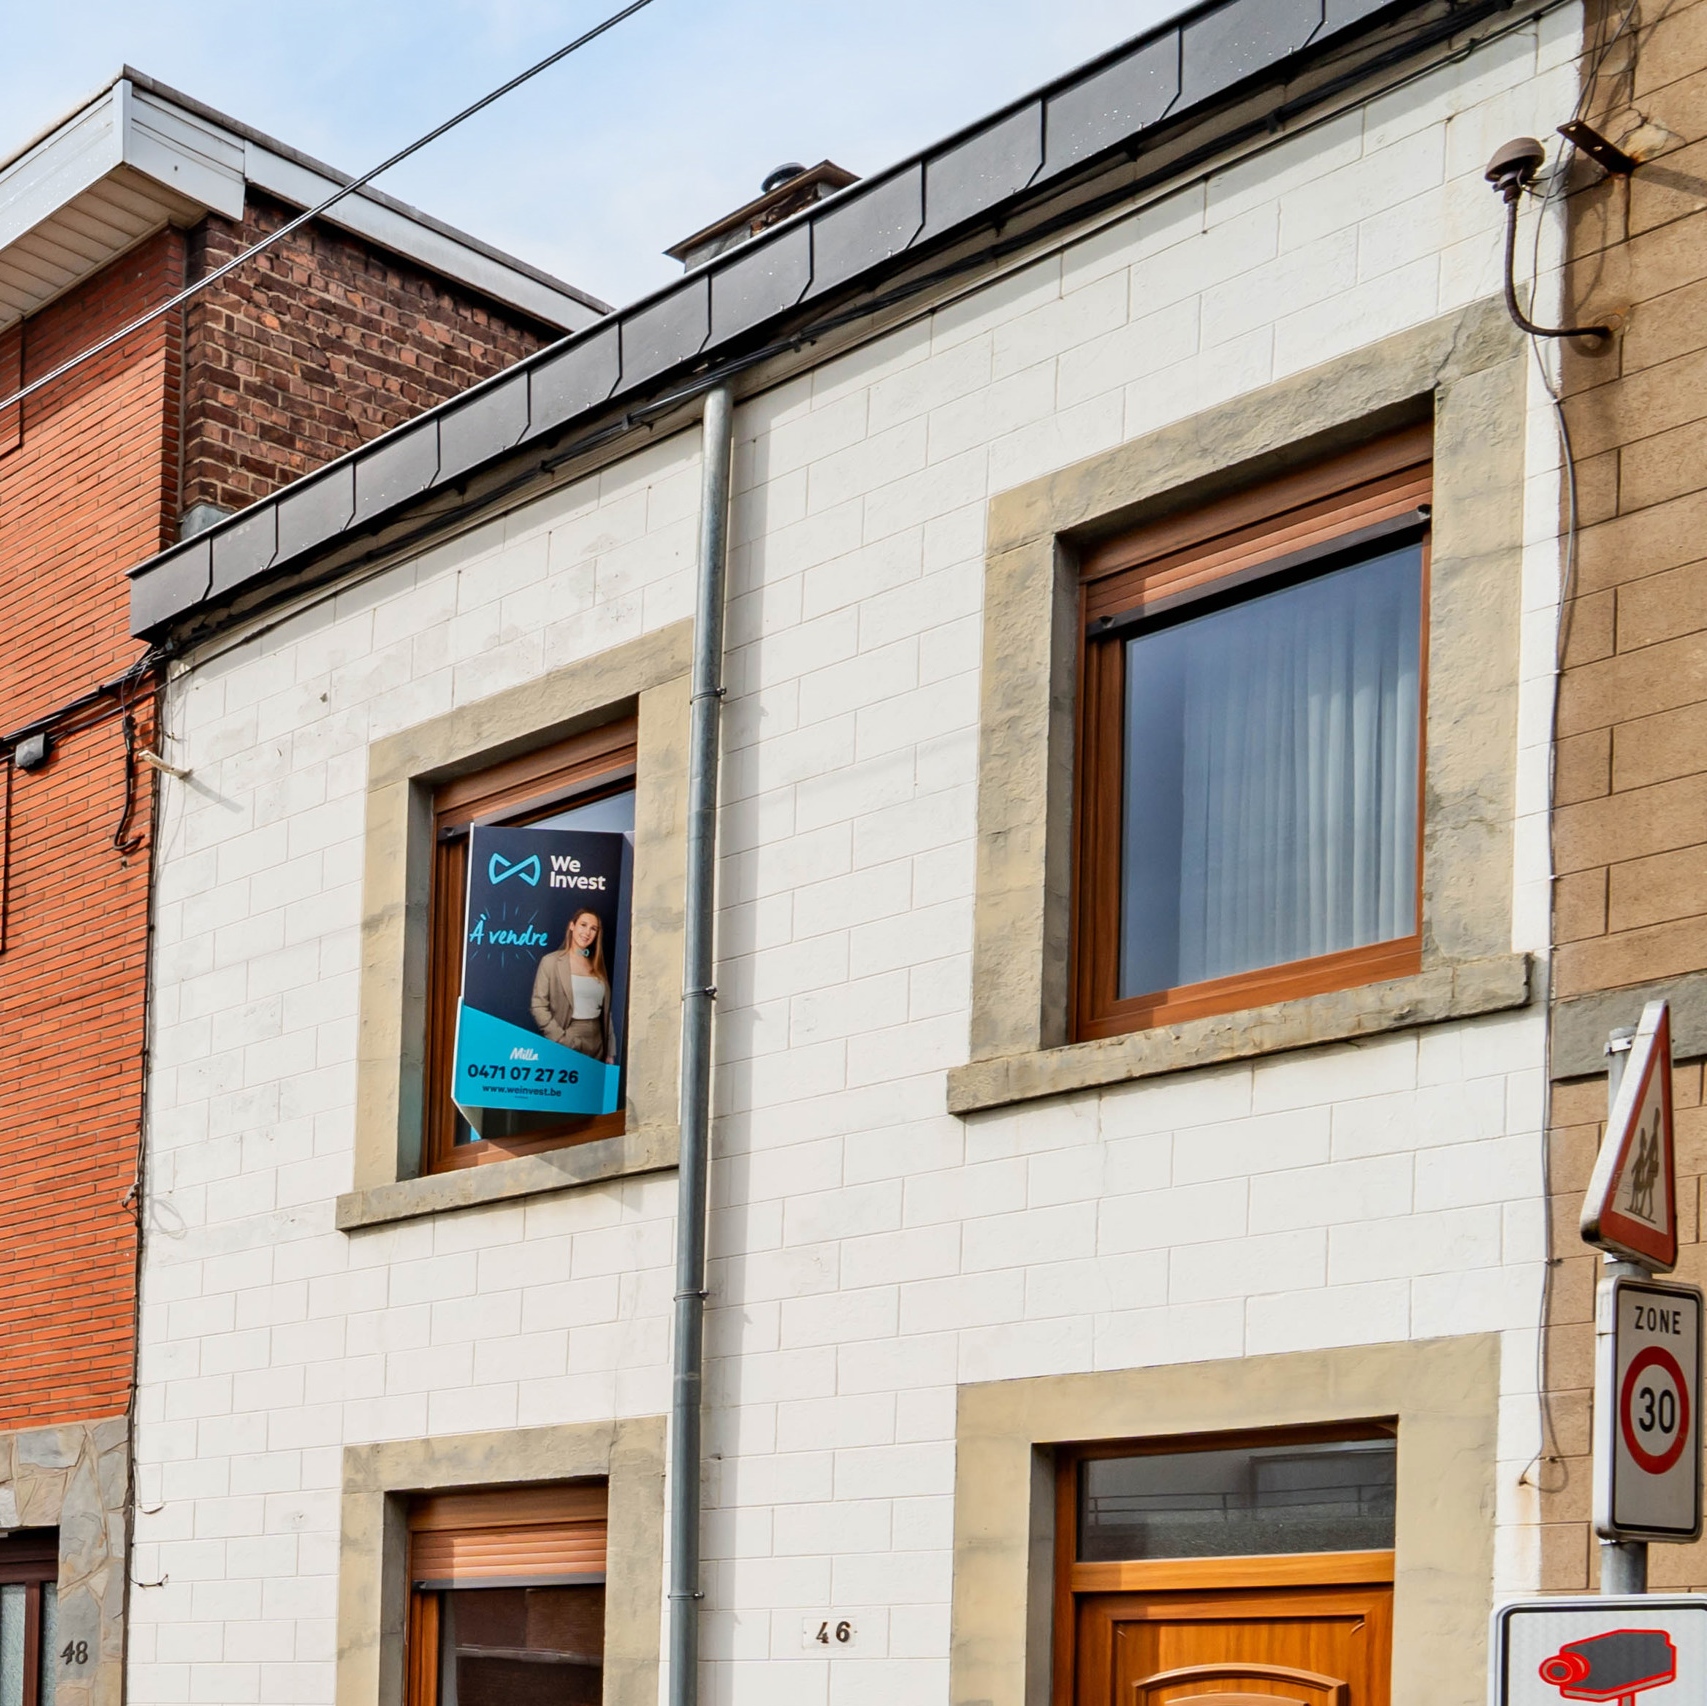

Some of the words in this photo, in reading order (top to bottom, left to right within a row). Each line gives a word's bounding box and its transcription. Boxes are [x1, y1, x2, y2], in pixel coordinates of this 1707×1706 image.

[550, 855, 581, 872] We
[550, 871, 606, 890] Invest
[469, 913, 487, 945] À
[489, 925, 548, 946] vendre
[467, 1064, 506, 1079] 0471
[510, 1066, 531, 1081] 07
[534, 1068, 554, 1082] 27
[558, 1069, 579, 1084] 26
[482, 1085, 562, 1097] www.weinvest.be
[1635, 1306, 1682, 1335] ZONE
[1639, 1387, 1675, 1434] 30
[815, 1621, 851, 1644] 46
[60, 1640, 89, 1665] 48
